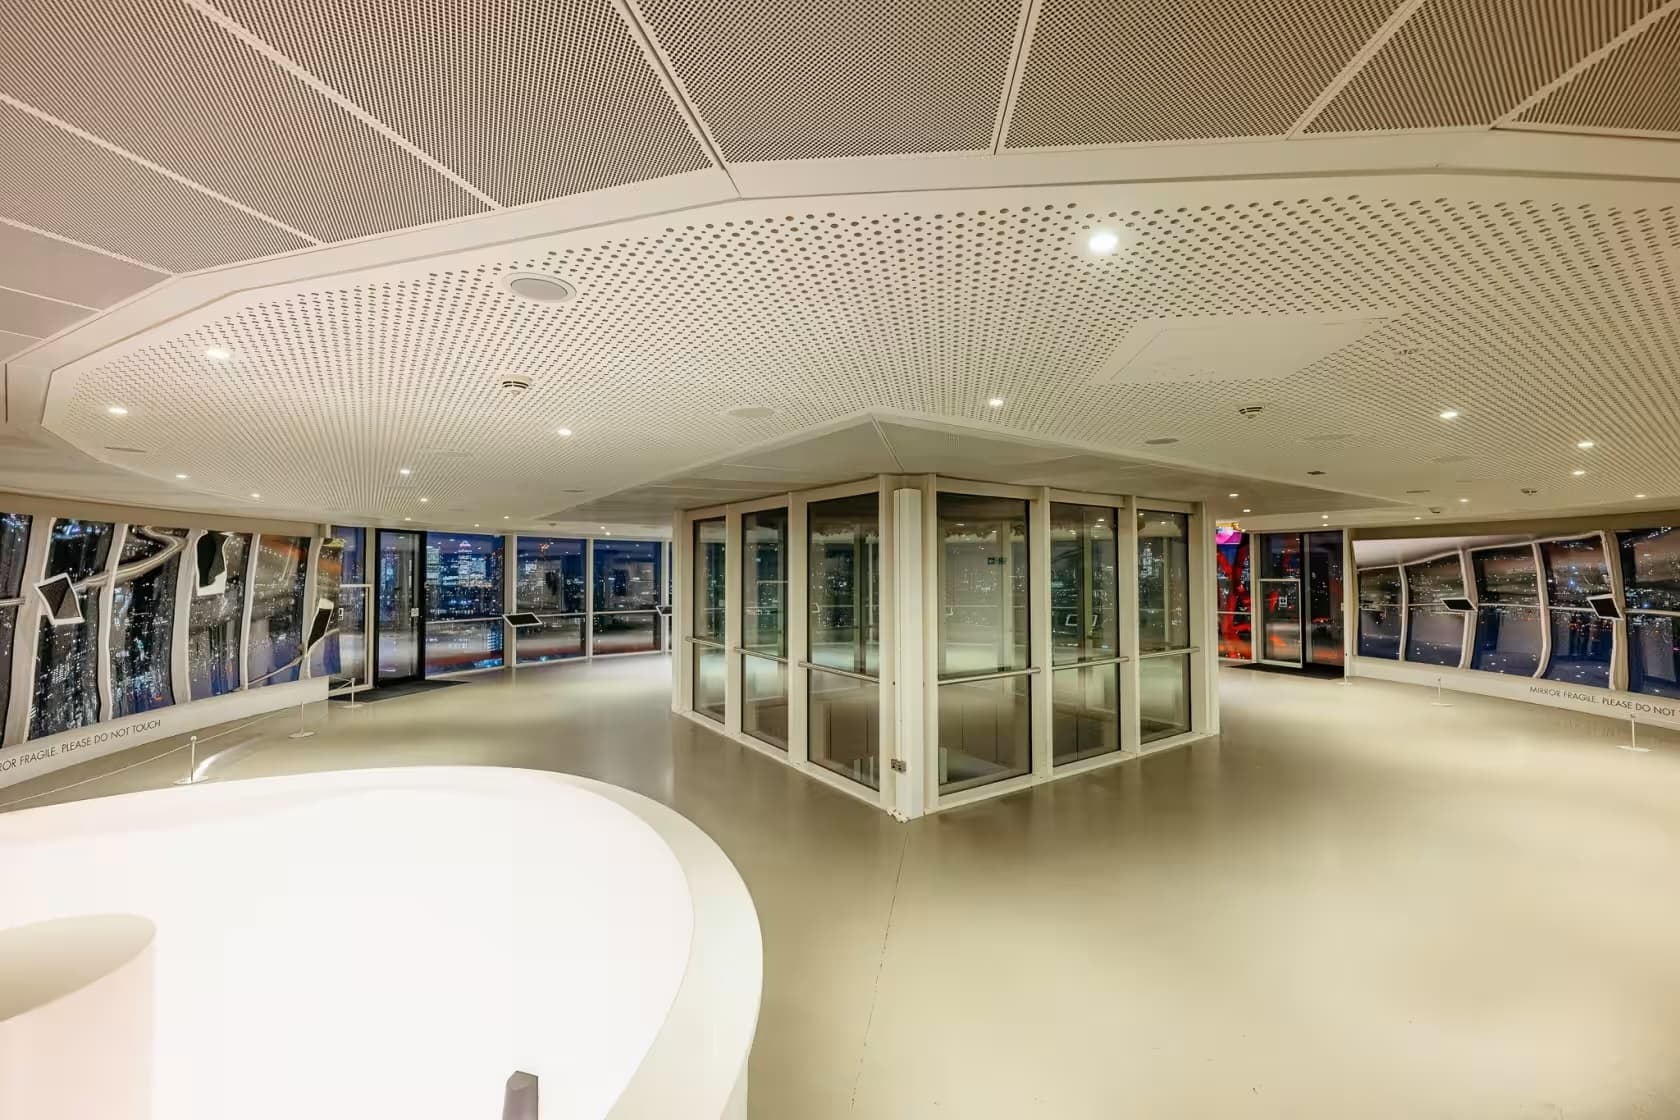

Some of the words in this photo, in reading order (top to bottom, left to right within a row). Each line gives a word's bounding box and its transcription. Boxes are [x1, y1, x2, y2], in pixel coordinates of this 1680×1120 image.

[1529, 686, 1561, 697] MIRROR
[1602, 697, 1633, 709] PLEASE
[1635, 703, 1651, 712] DO
[1654, 707, 1676, 717] NOT
[20, 748, 59, 765] FRAGILE.
[61, 738, 92, 753] PLEASE
[94, 733, 108, 744] DO
[110, 727, 130, 739] NOT
[132, 720, 161, 734] TOUCH
